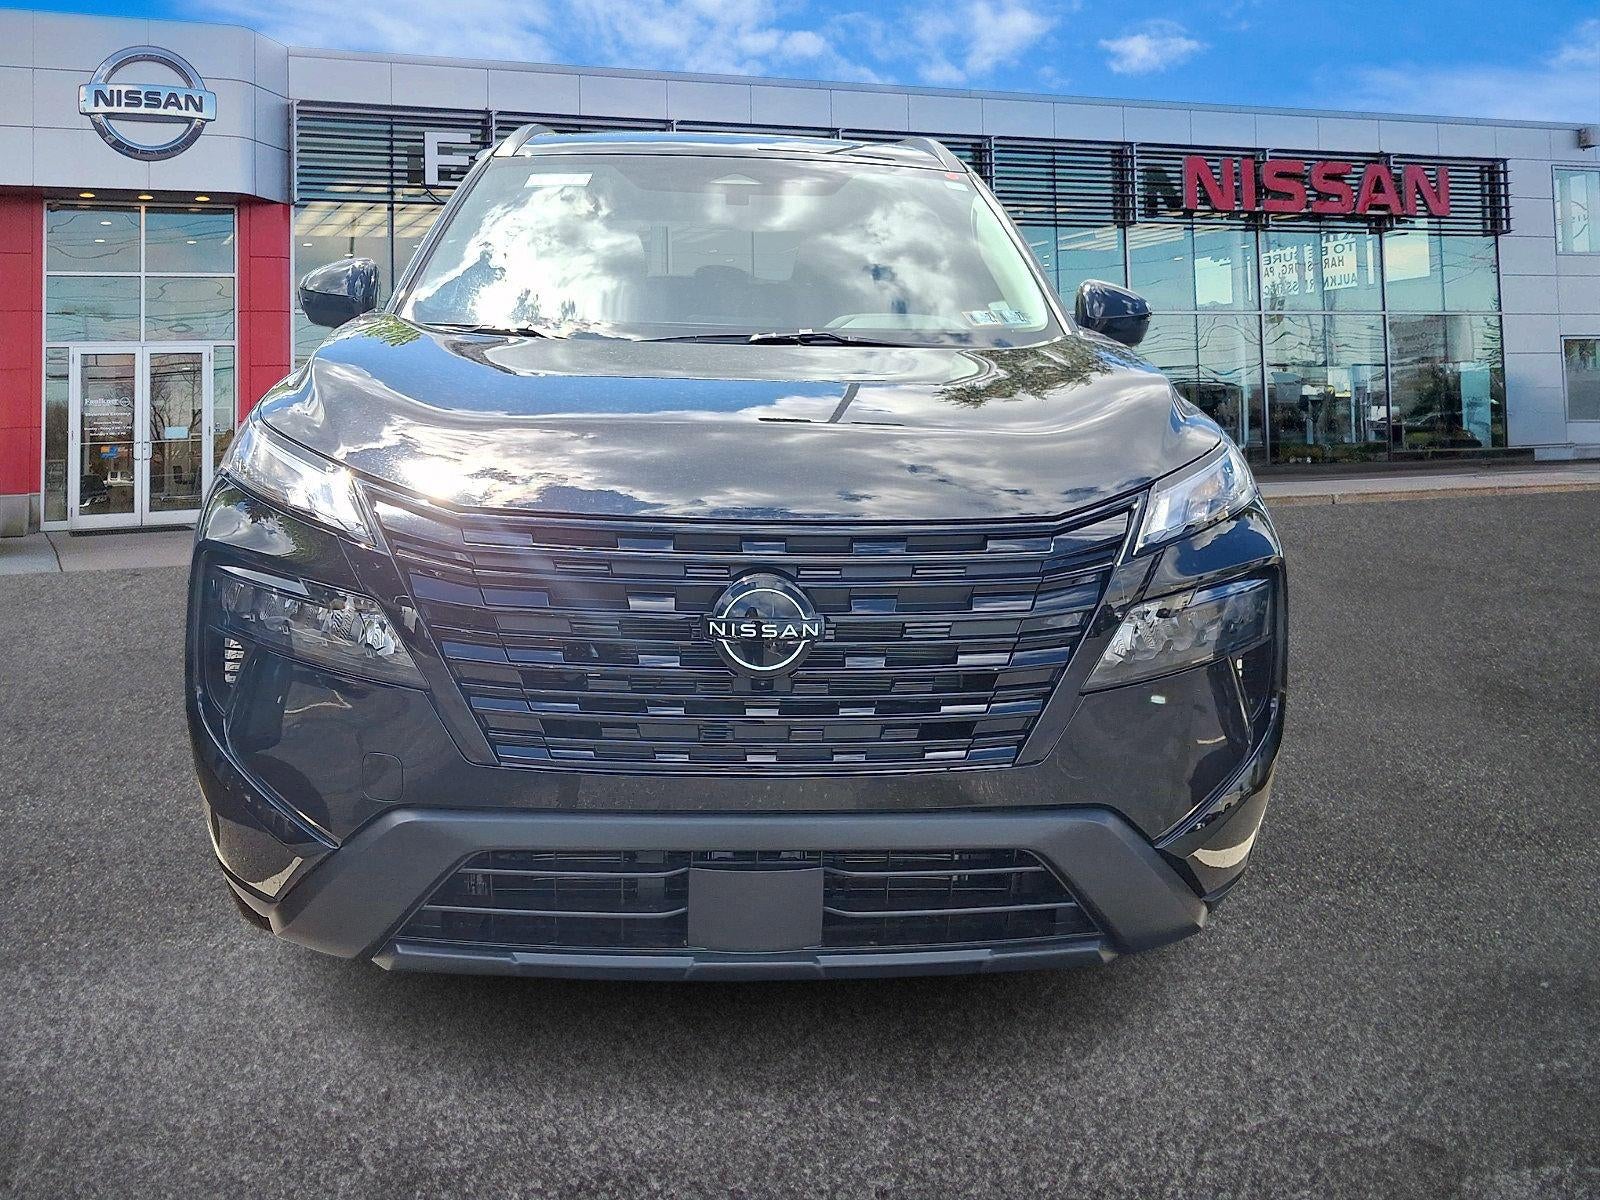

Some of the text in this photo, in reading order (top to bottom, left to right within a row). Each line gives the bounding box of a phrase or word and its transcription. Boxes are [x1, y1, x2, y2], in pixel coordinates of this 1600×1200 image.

[93, 89, 203, 113] NISSAN
[1183, 155, 1451, 216] NISSAN
[709, 621, 819, 638] NISSAN
